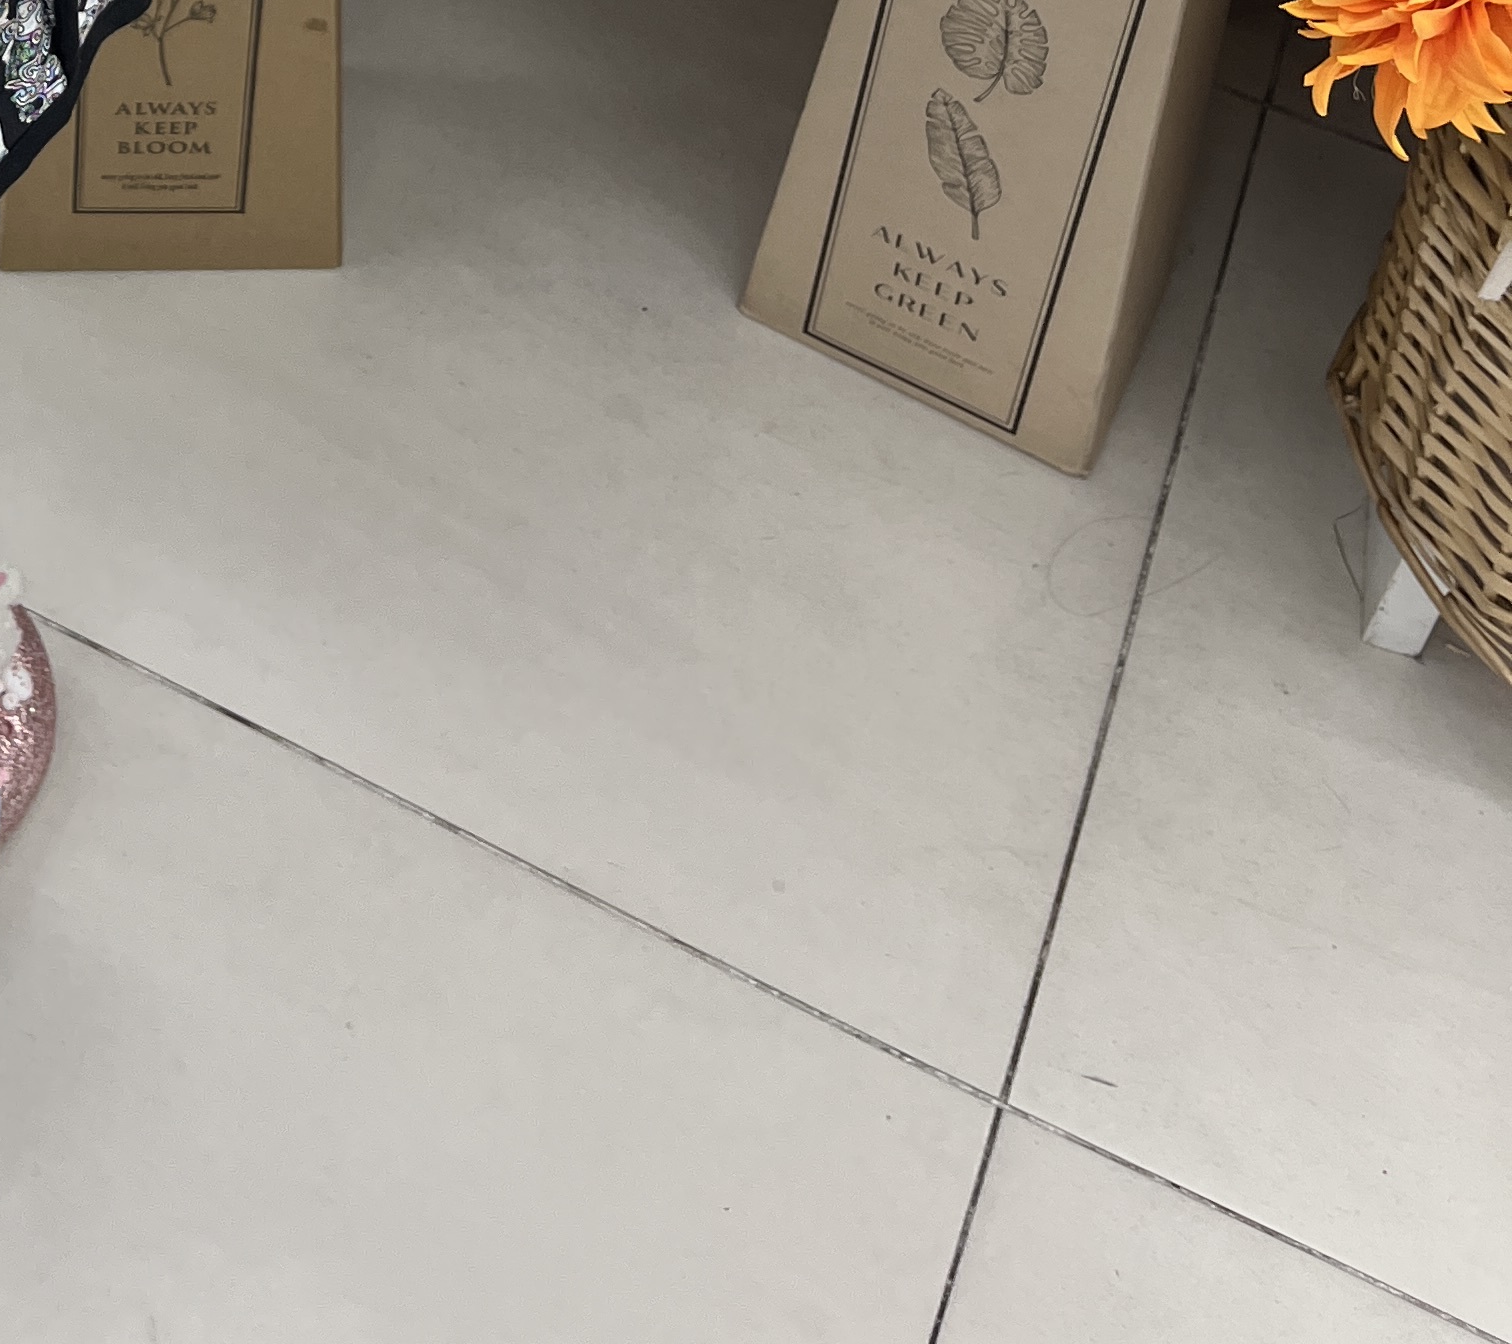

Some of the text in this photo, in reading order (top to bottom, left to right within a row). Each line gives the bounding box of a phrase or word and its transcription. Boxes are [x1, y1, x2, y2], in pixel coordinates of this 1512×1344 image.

[115, 101, 218, 116] ALWAYS
[134, 121, 198, 135] KEEP
[116, 140, 212, 155] BLOOM
[872, 225, 1009, 297] ALWAYS
[893, 263, 974, 305] KEEP
[874, 284, 979, 342] GREEN
